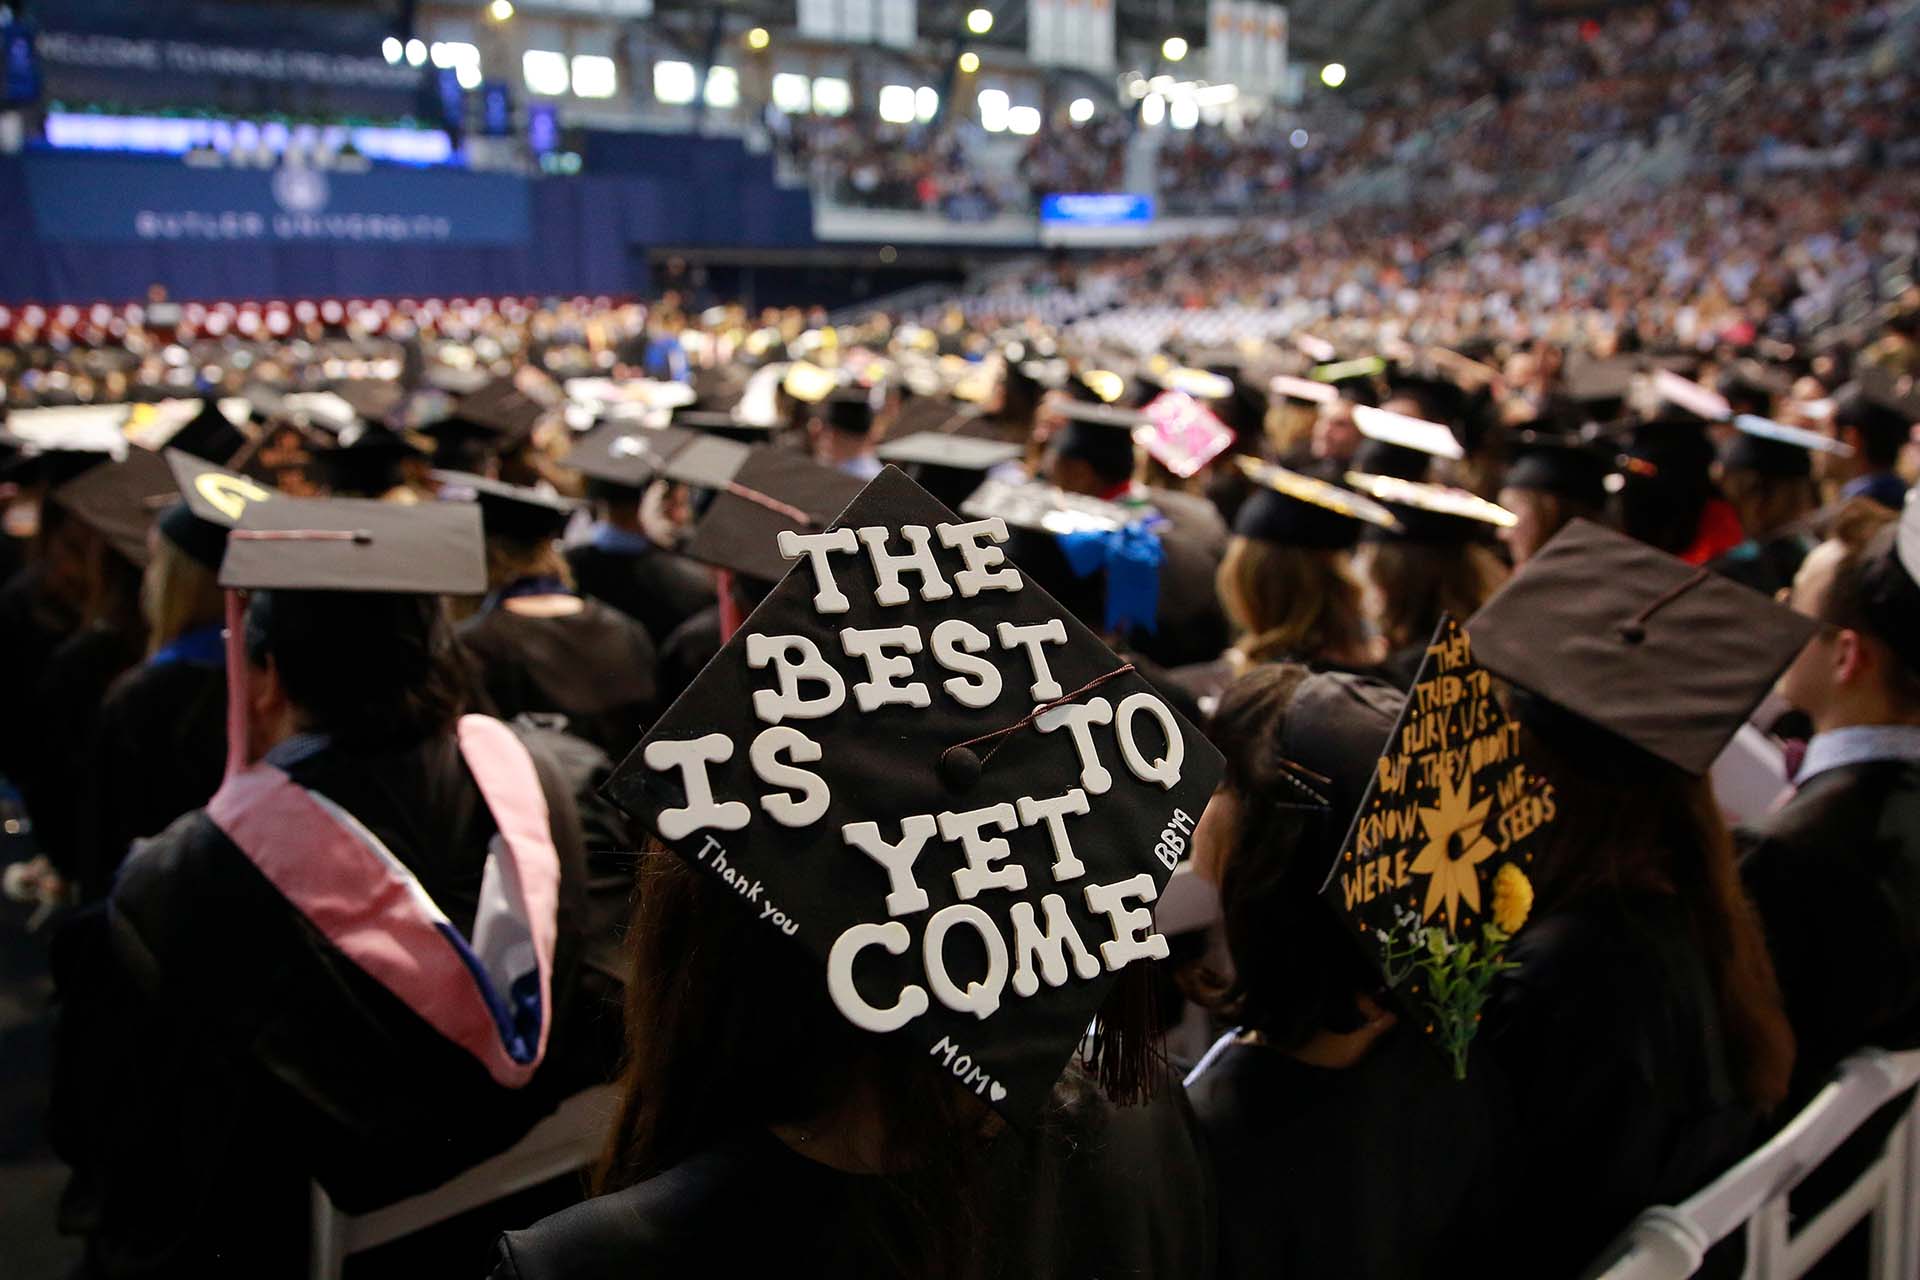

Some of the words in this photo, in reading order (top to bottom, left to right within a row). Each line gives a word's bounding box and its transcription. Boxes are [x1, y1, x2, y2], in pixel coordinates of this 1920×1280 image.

[778, 517, 1023, 614] THE
[746, 619, 1068, 724] BEST
[1466, 669, 1491, 698] TO
[1460, 699, 1489, 739] US
[644, 726, 831, 840] IS
[1378, 753, 1411, 796] BUT
[1419, 745, 1468, 788] THEY
[1497, 764, 1526, 808] WE
[1357, 800, 1418, 855] KNOW
[1498, 784, 1557, 852] SEEDS
[842, 788, 1090, 916] YET
[1342, 849, 1409, 911] WERE
[698, 834, 764, 902] Thank
[759, 900, 799, 935] you
[930, 1036, 991, 1096] MOM
